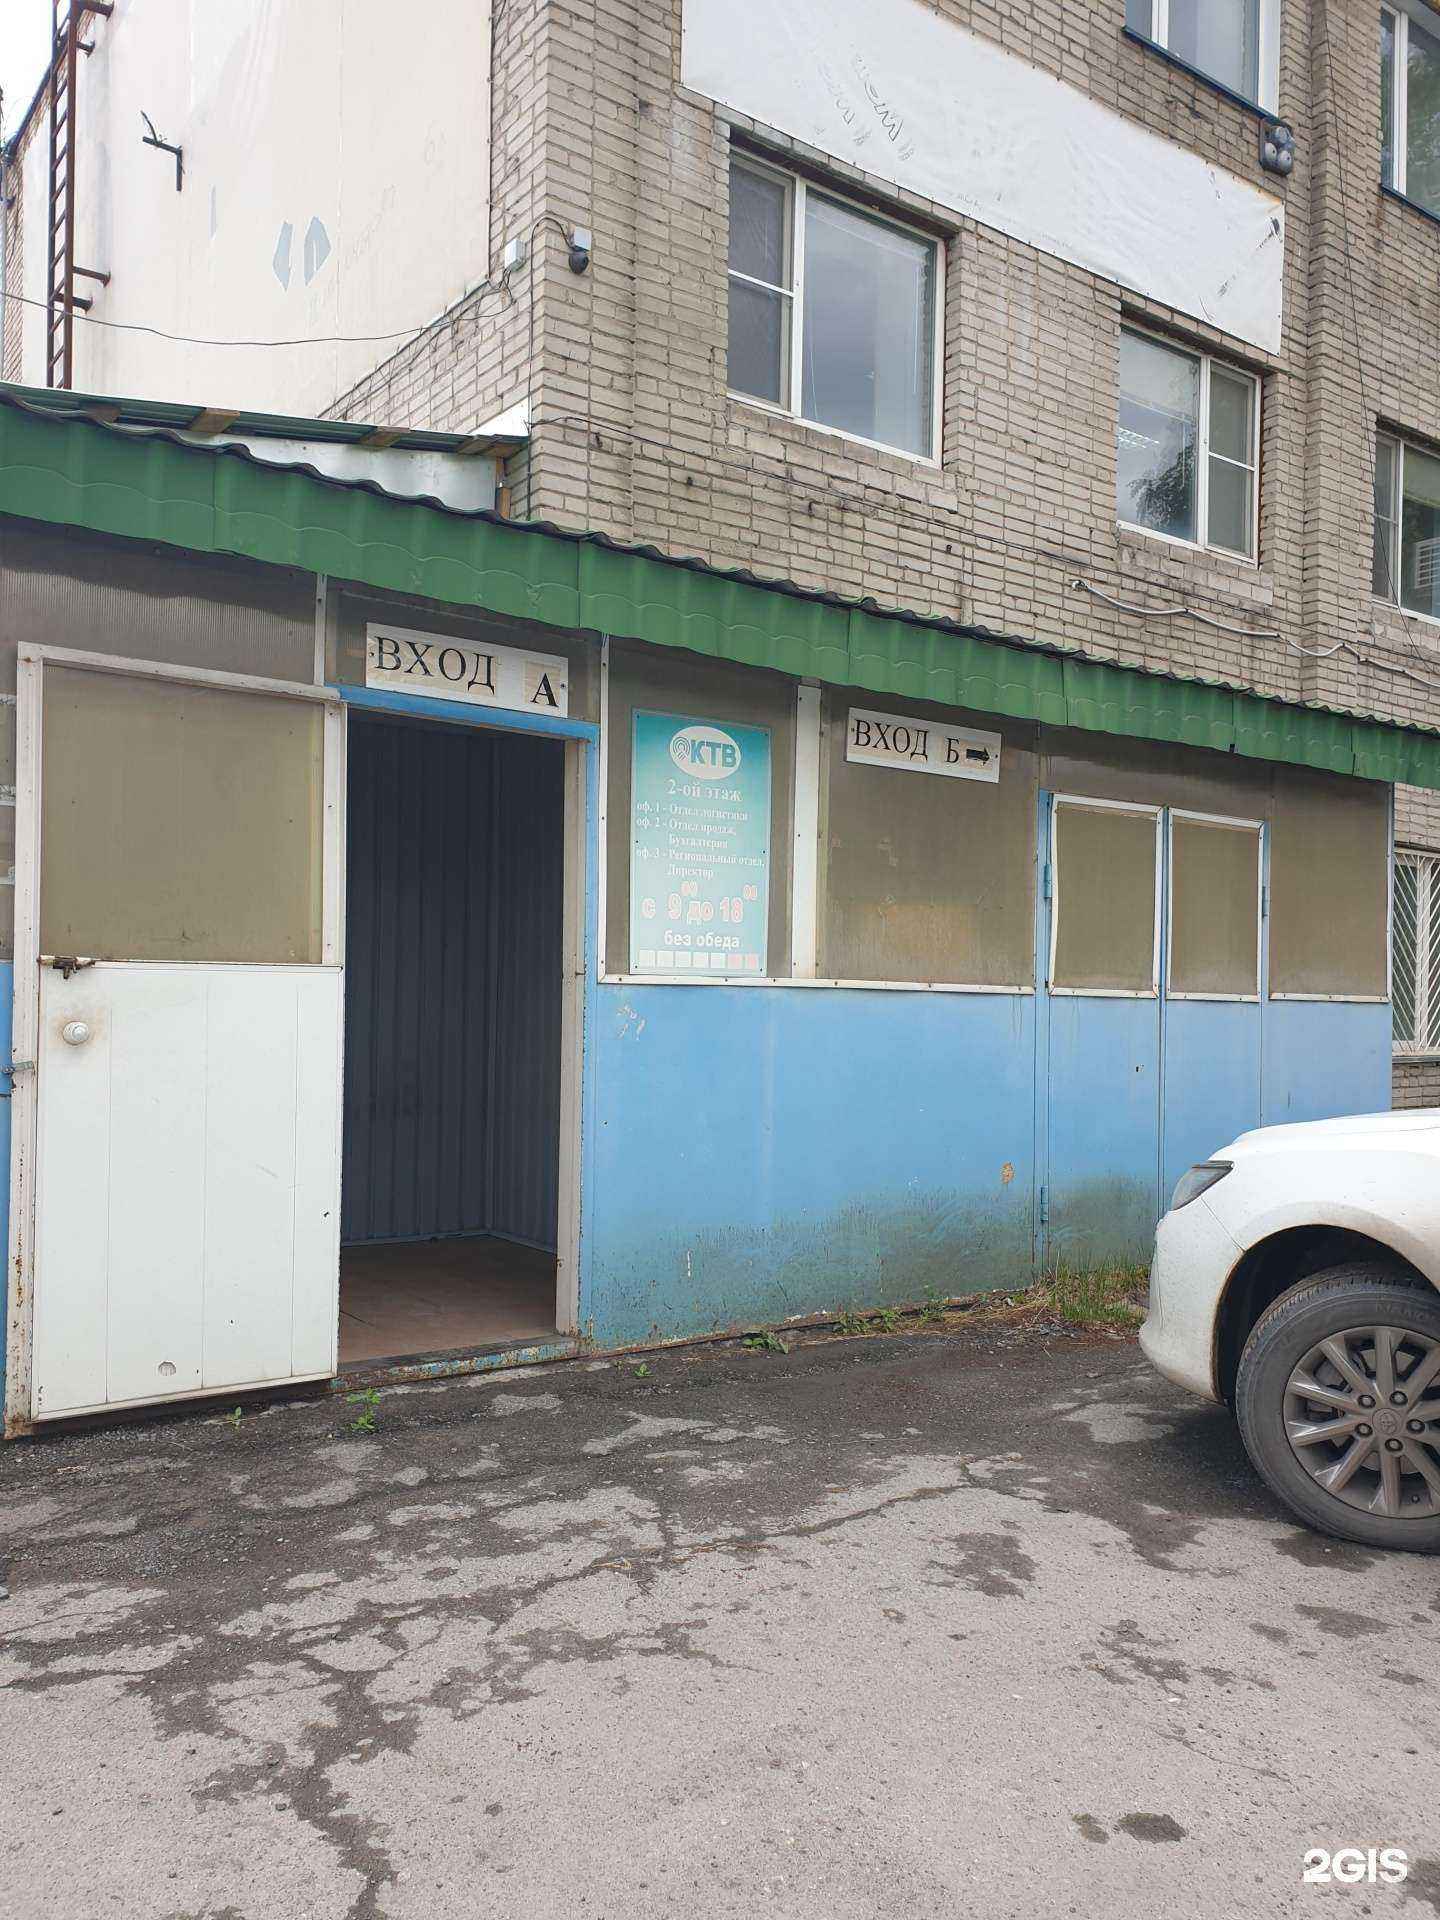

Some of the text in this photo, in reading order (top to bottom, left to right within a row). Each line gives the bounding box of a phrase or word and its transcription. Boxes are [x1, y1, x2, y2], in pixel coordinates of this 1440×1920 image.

[374, 636, 560, 708] ВХОД А
[690, 739, 737, 767] КТВ
[853, 719, 961, 764] ВХОД Б
[665, 778, 743, 802] 2-ой этаж
[687, 899, 714, 926] до
[664, 928, 740, 950] без обеда
